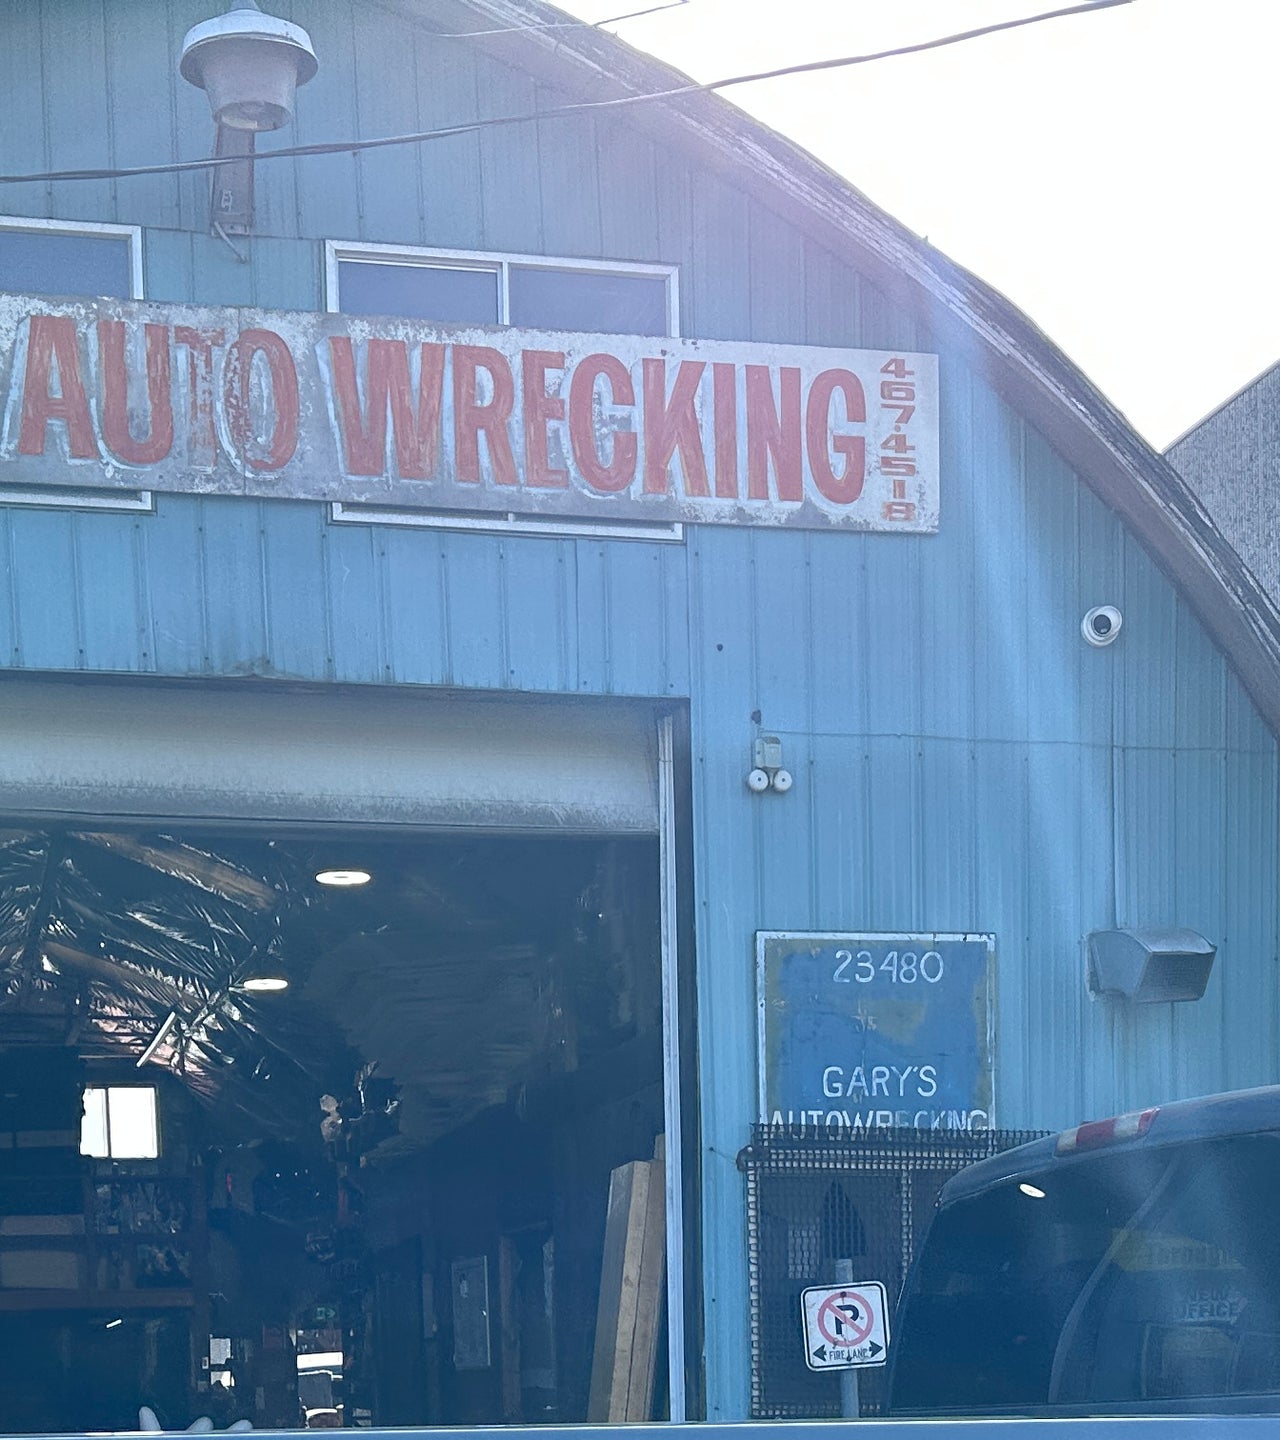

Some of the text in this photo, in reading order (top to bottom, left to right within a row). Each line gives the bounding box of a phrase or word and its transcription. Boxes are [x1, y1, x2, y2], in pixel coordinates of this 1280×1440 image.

[19, 313, 299, 470] AUTO
[328, 334, 867, 505] WRECKING
[832, 950, 944, 983] 23480
[823, 1065, 937, 1098] GARY'S
